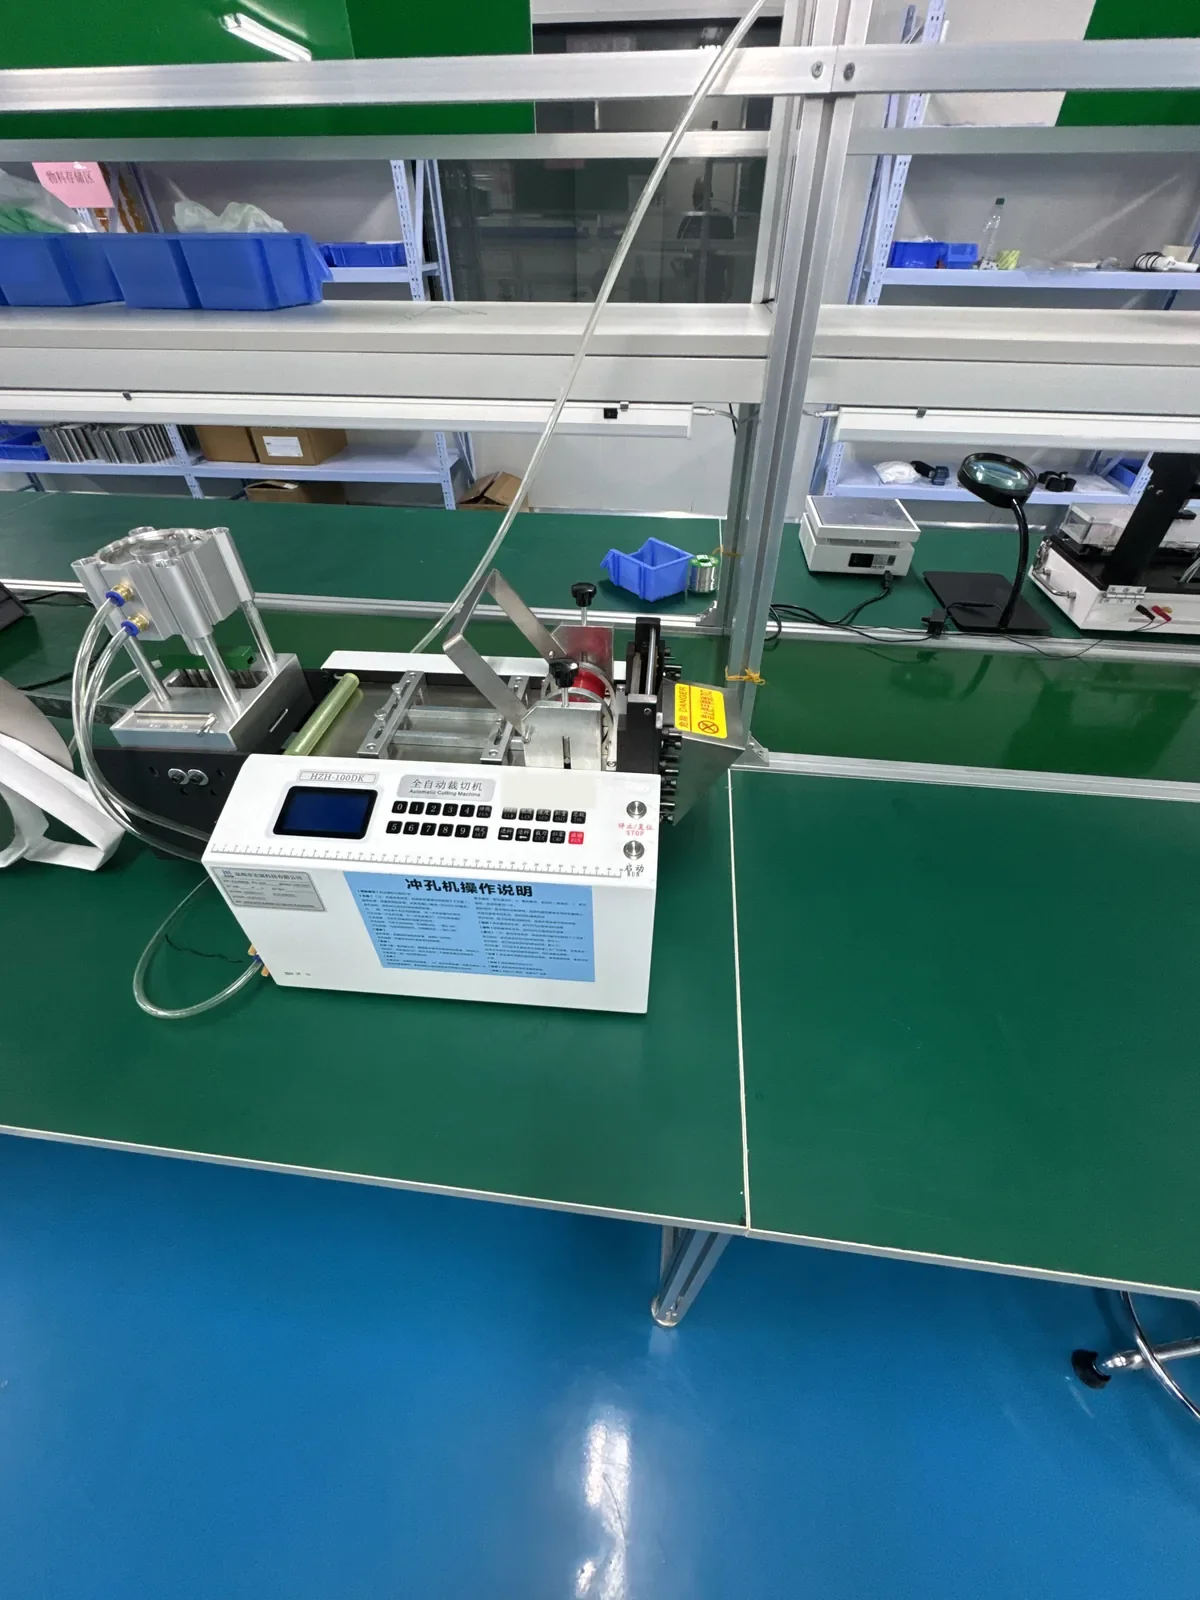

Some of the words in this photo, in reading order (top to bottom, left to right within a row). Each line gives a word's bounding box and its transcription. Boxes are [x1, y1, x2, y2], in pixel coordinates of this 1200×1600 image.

[679, 686, 688, 713] DANGER
[310, 772, 365, 782] HZH-100DK
[411, 778, 483, 791] 全自动裁切机
[624, 863, 644, 873] 启动
[405, 879, 533, 897] 冲孔机操作说明
